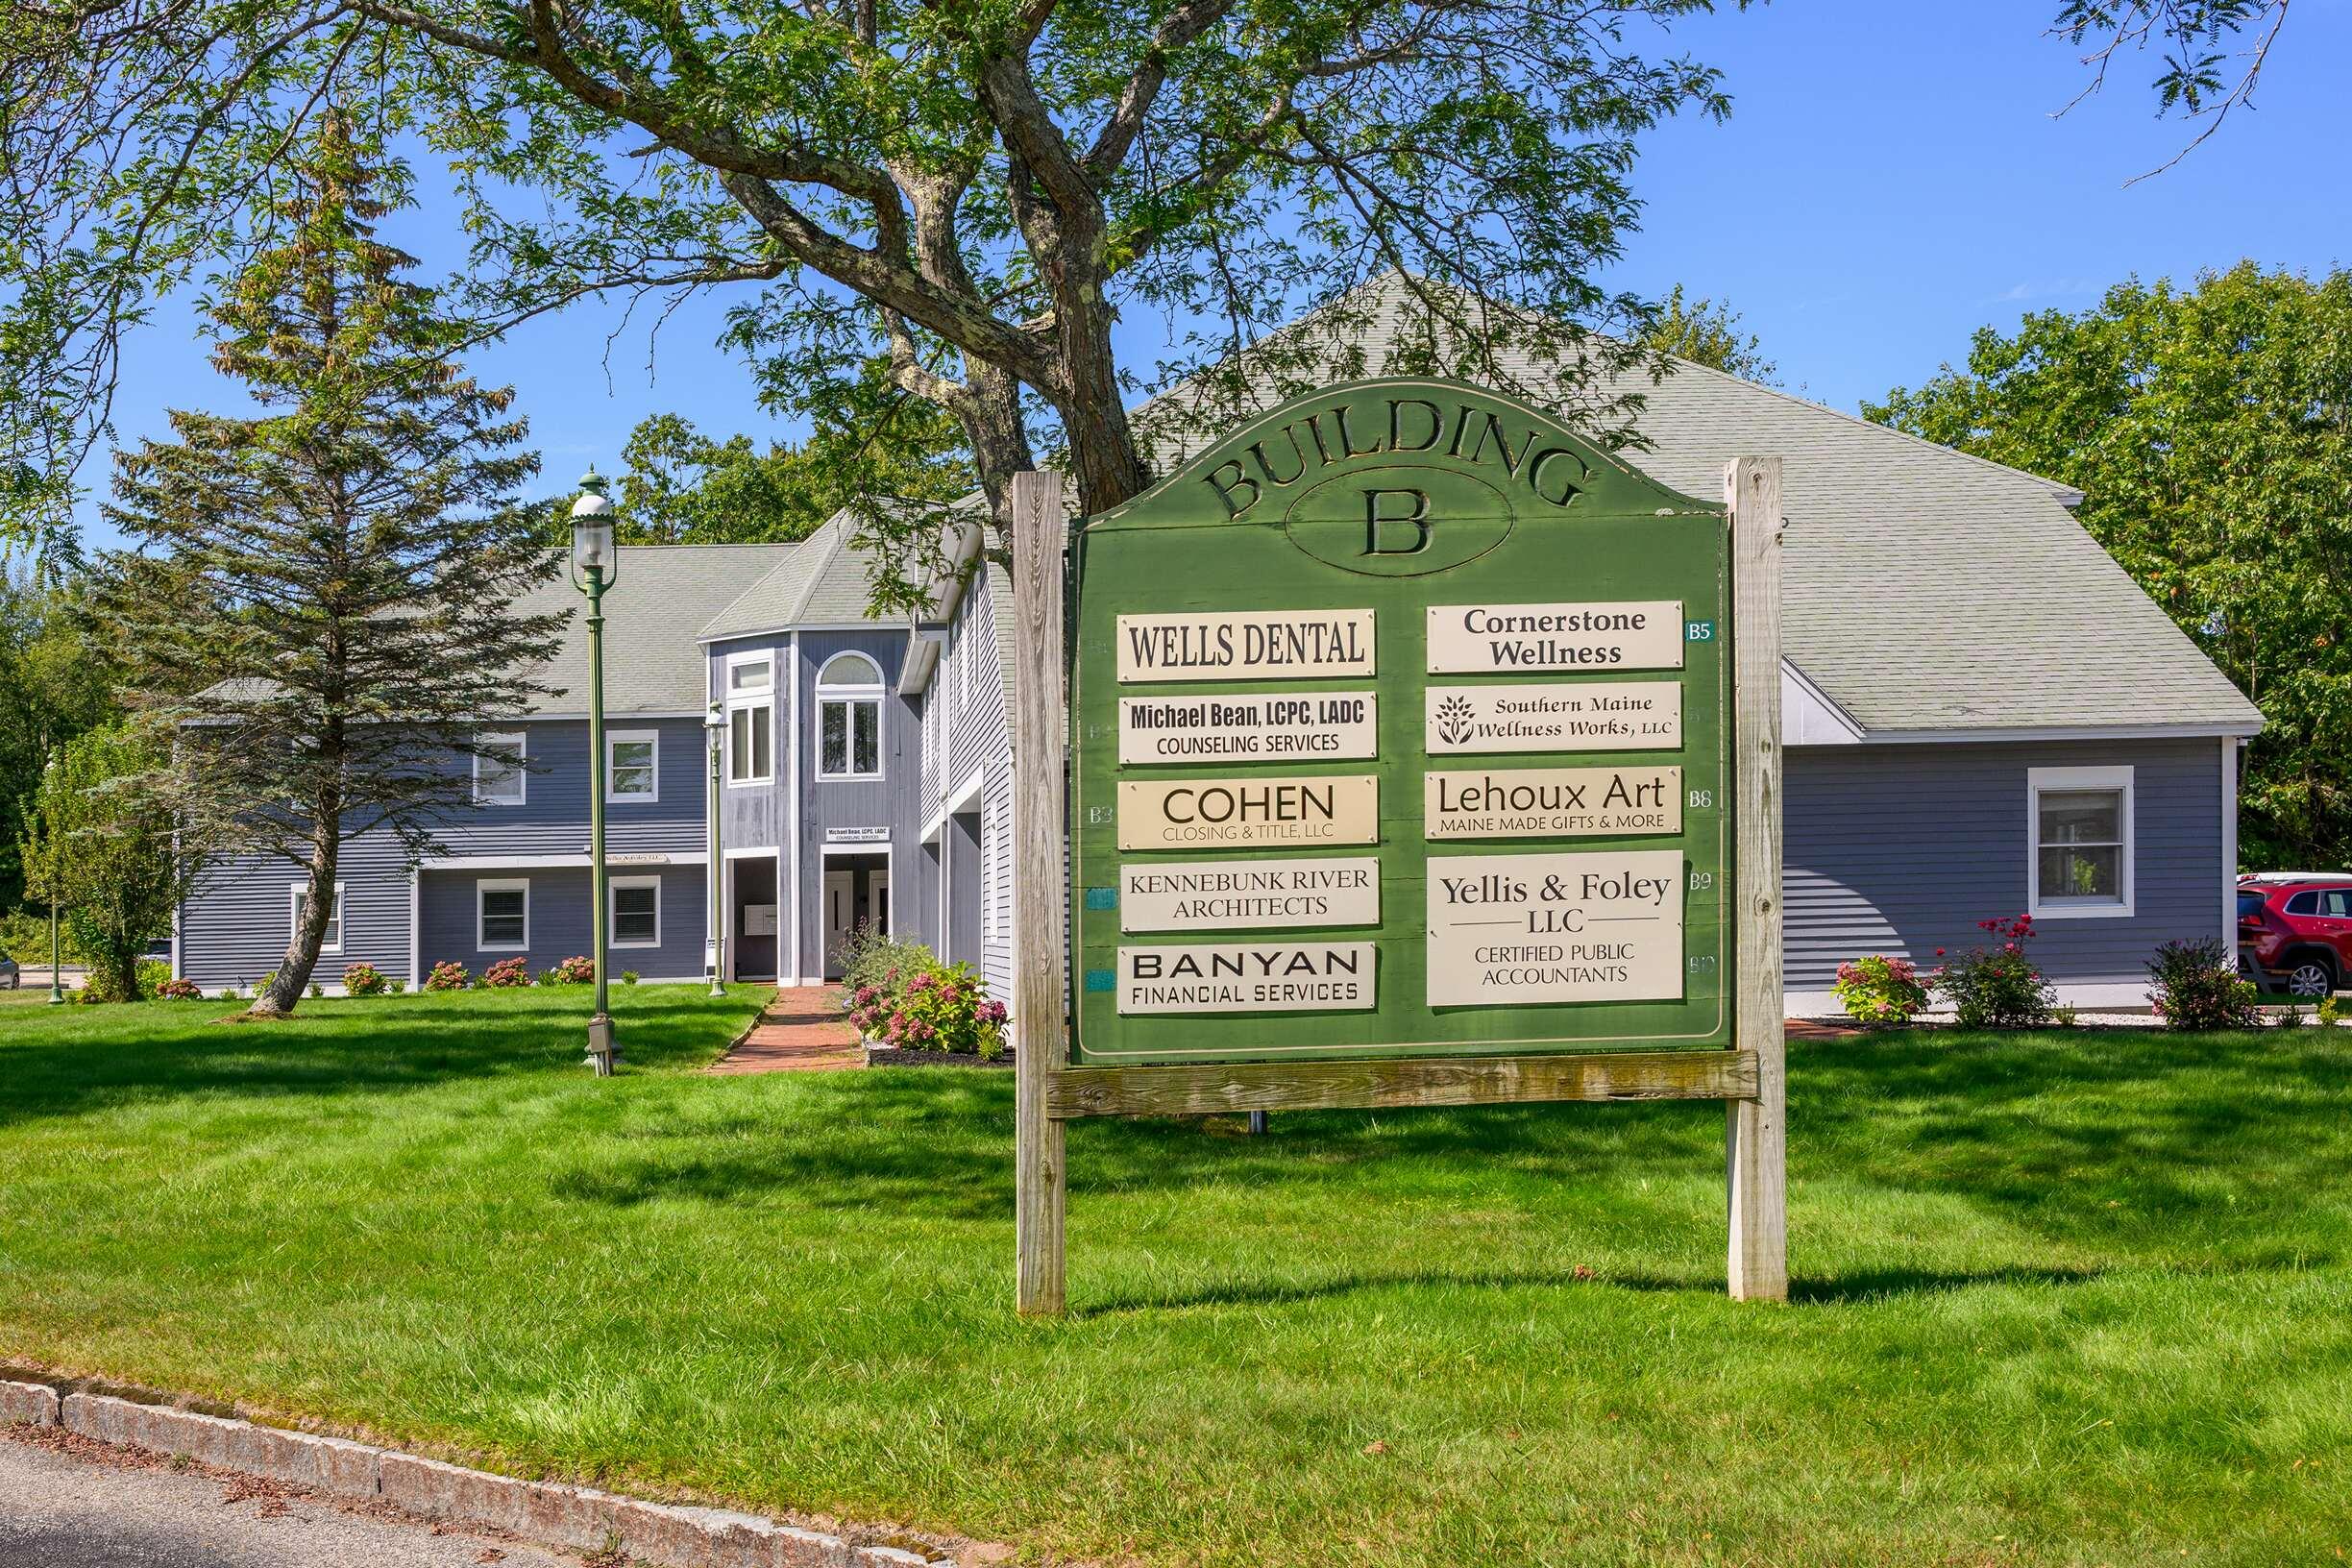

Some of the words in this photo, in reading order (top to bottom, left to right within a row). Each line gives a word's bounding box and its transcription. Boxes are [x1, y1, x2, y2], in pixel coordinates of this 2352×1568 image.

[1201, 400, 1596, 522] BUILDING
[1360, 488, 1434, 556] B
[1463, 608, 1646, 634] Cornerstone
[1689, 623, 1710, 640] B5
[1129, 625, 1235, 669] WELLS
[1243, 621, 1365, 665] DENTAL
[1489, 639, 1622, 666] Wellness
[1131, 703, 1206, 729] Michael
[1211, 702, 1262, 728] Bean,
[1266, 700, 1314, 727] LCPC,
[1319, 699, 1365, 724] LADC
[1495, 697, 1583, 714] Southern
[1589, 695, 1654, 712] Maine
[1477, 720, 1562, 738] Wellness
[1569, 719, 1635, 738] Works,
[1641, 721, 1673, 735] LLC
[1157, 736, 1259, 754] COUNSELING
[1265, 733, 1339, 752] SERVICES
[1163, 784, 1334, 824] COHEN
[1439, 775, 1587, 813] Lehoux
[1603, 773, 1666, 809] Art
[1689, 790, 1712, 808] B8
[1163, 824, 1237, 842] CLOSING
[1241, 824, 1253, 840] &
[1256, 823, 1301, 839] TITLE,
[1305, 822, 1334, 838] LLC
[1440, 818, 1494, 832] MAINE
[1499, 817, 1547, 831] MADE
[1551, 815, 1595, 829] GIFTS
[1599, 815, 1611, 829] &
[1616, 814, 1665, 828] MORE
[1130, 871, 1286, 894] KENNEBUNK
[1292, 869, 1370, 890] RIVER
[1439, 874, 1528, 904] Yellis
[1539, 873, 1568, 902] &
[1580, 870, 1672, 906] Foley
[1690, 871, 1711, 891] B9
[1173, 895, 1329, 919] ARCHITECTS
[1527, 908, 1584, 934] LLC
[1133, 949, 1358, 979] BANYAN
[1475, 945, 1563, 964] CERTIFIED
[1571, 943, 1636, 961] PUBLIC
[1482, 966, 1629, 987] ACCOUNTANTS
[1132, 985, 1245, 1005] FINANCIAL
[1254, 982, 1358, 1002] SERVICES
